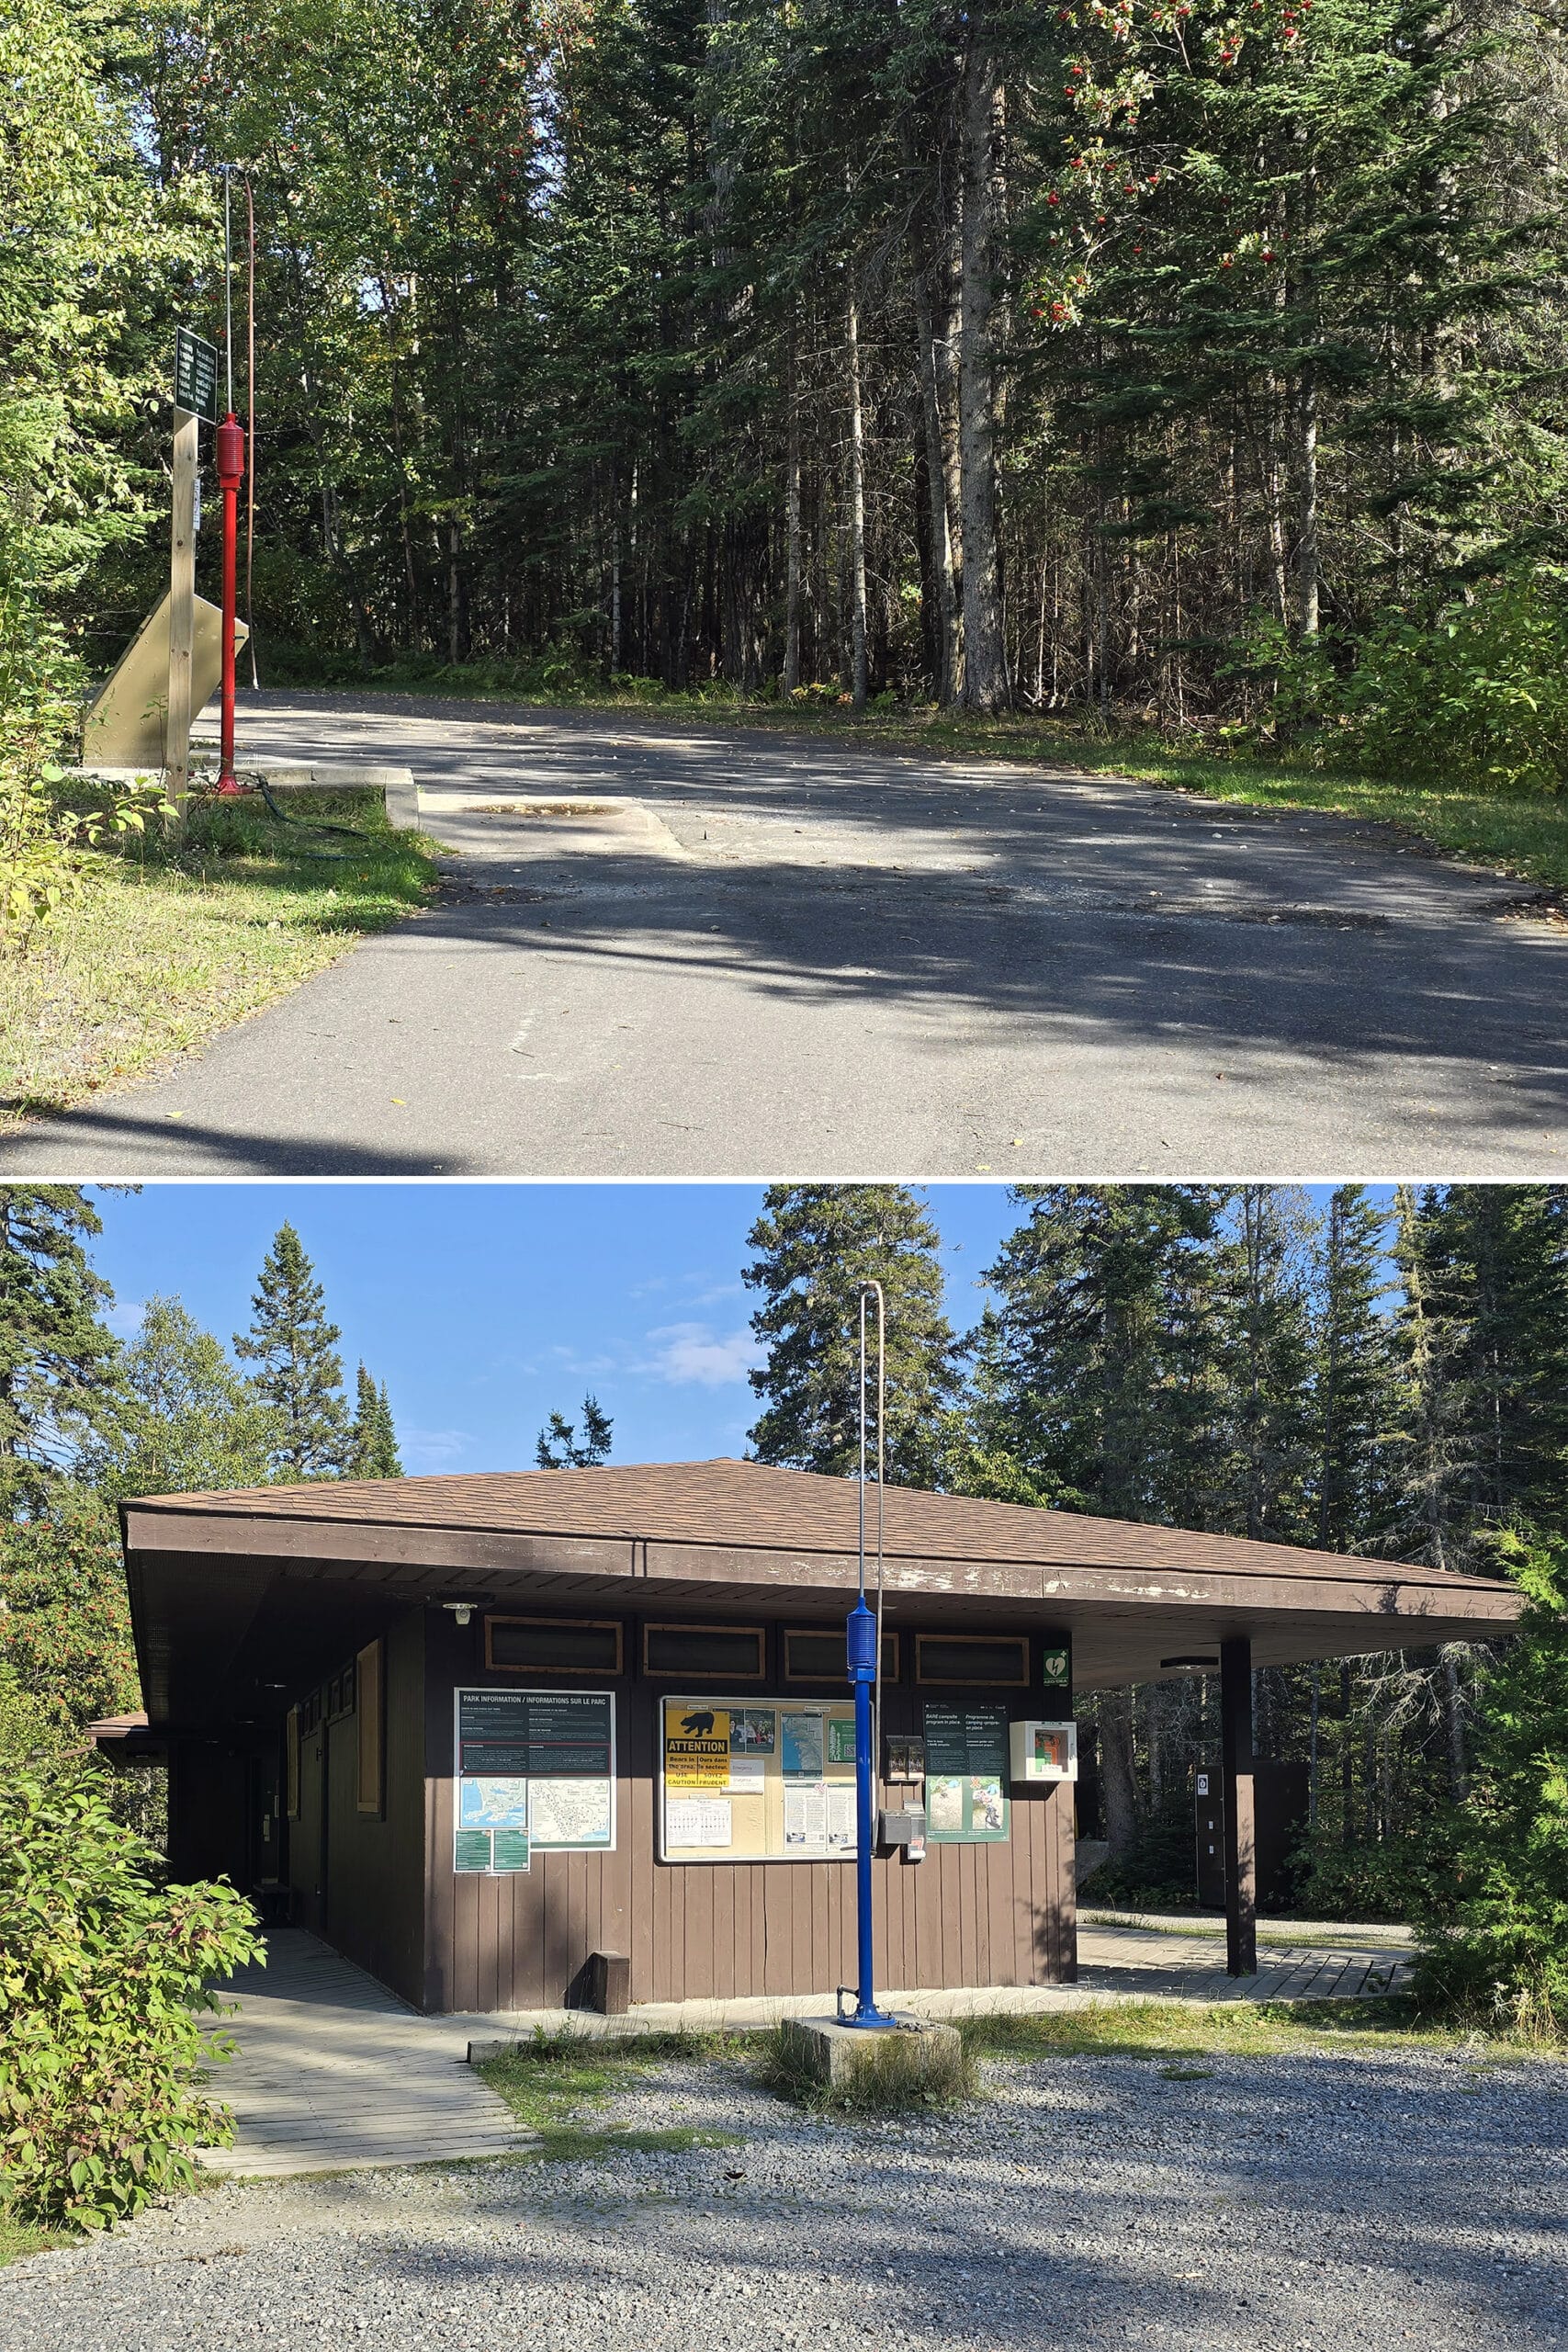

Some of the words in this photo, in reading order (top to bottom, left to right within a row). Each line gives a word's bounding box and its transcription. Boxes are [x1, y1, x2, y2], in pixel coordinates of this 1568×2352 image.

[480, 1695, 521, 1703] INFORMATION
[526, 1696, 570, 1704] INFORMATIONS
[669, 1741, 725, 1752] ATTENTION
